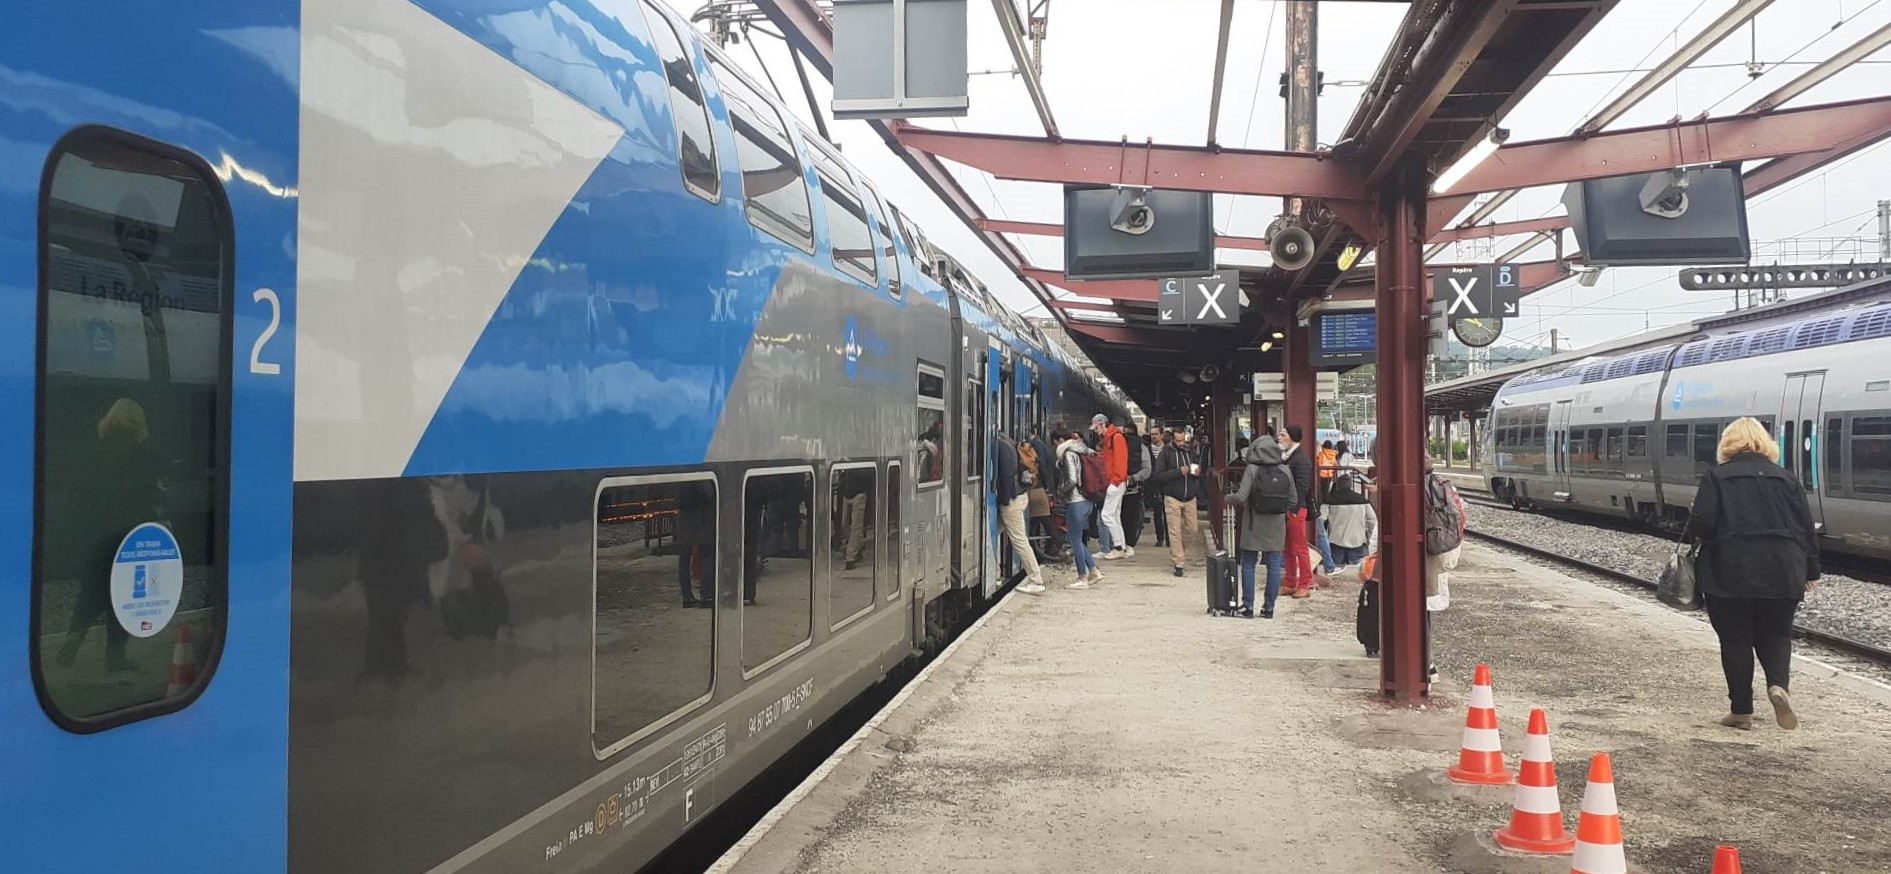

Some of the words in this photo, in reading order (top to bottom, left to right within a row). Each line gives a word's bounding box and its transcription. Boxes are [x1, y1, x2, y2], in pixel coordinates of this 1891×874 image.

[1165, 281, 1177, 292] C
[1447, 277, 1479, 314] X
[1500, 272, 1512, 284] D
[1196, 283, 1227, 320] X
[250, 287, 281, 375] 2
[685, 788, 694, 822] F
